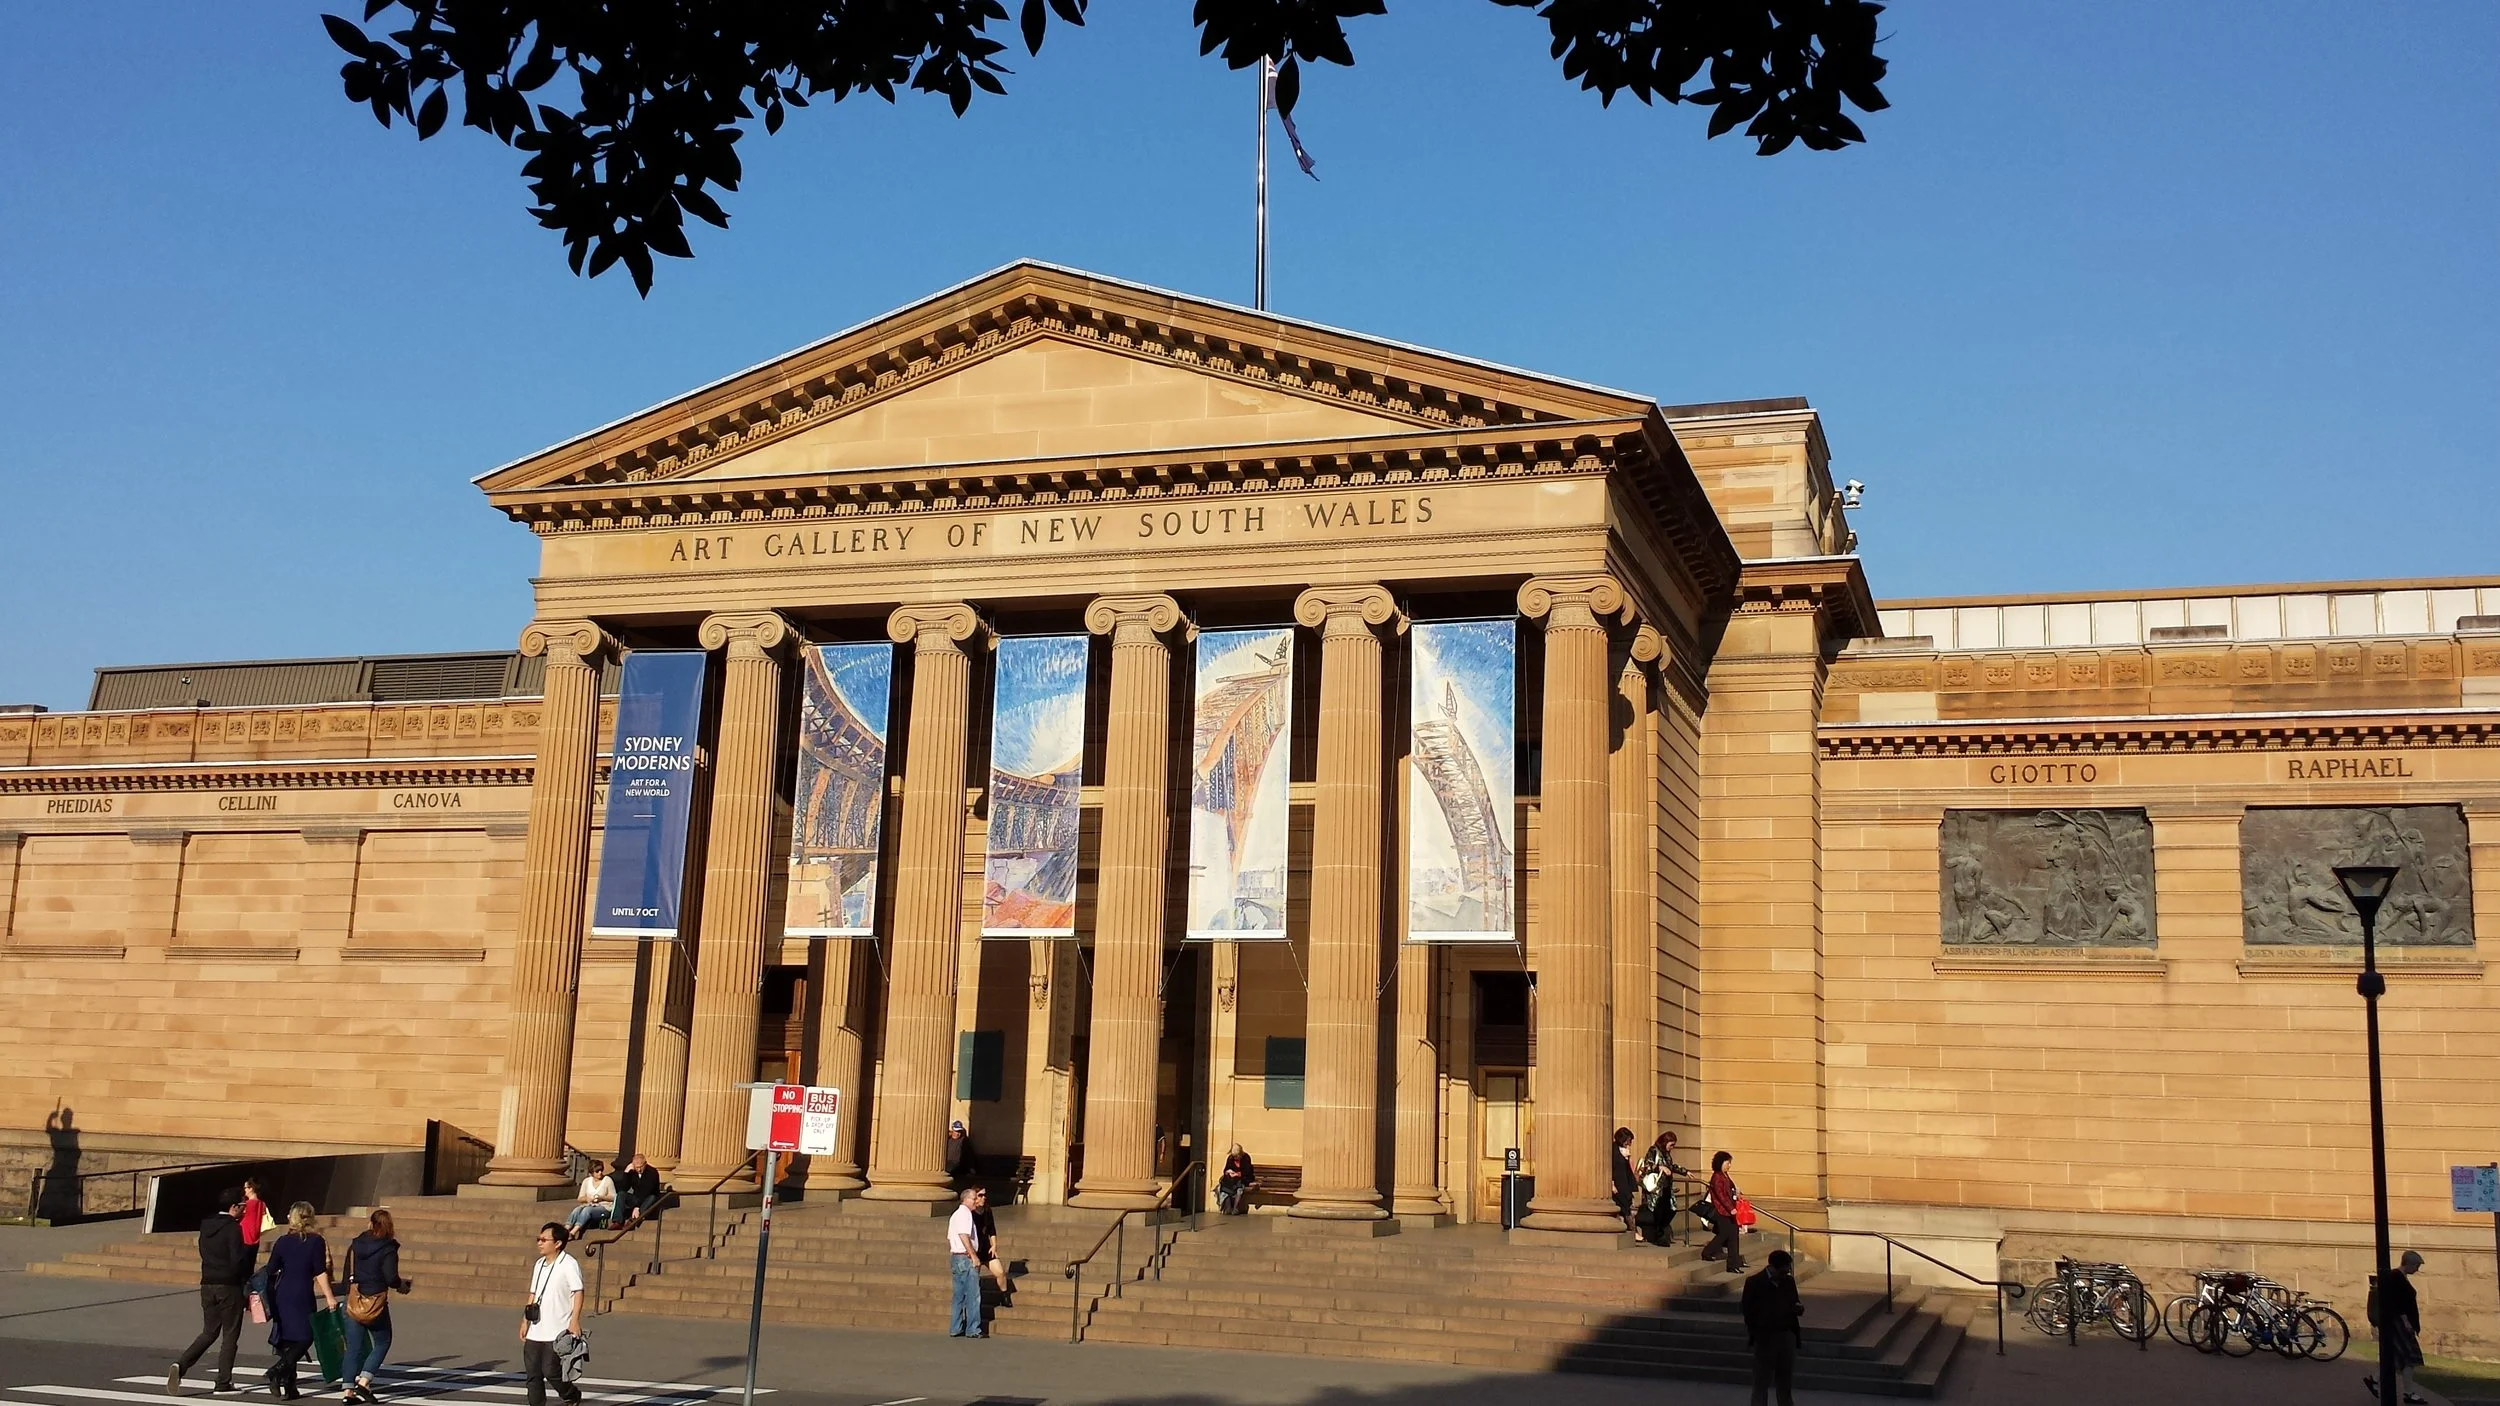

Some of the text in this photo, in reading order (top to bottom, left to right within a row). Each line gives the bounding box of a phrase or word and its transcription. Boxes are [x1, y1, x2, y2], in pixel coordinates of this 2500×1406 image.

[669, 496, 1433, 562] ART GALLERY OF NEW SOUTH WALES
[624, 736, 683, 752] SYDNEY
[614, 755, 691, 771] MODERNS
[2287, 757, 2414, 780] RAPHAEL
[1990, 763, 2098, 784] GIOTTO
[630, 778, 667, 787] ART FOR A
[393, 792, 462, 808] CANOVA
[625, 788, 643, 797] NEW
[643, 788, 670, 797] WORLD
[46, 798, 113, 814] PHEIDIAS
[218, 795, 278, 811] CELLINI
[612, 907, 660, 917] UNTIL 7 OCT
[782, 1090, 796, 1100] NO
[811, 1093, 835, 1104] BUS
[773, 1103, 803, 1114] STOPPING
[807, 1103, 835, 1113] ZONE
